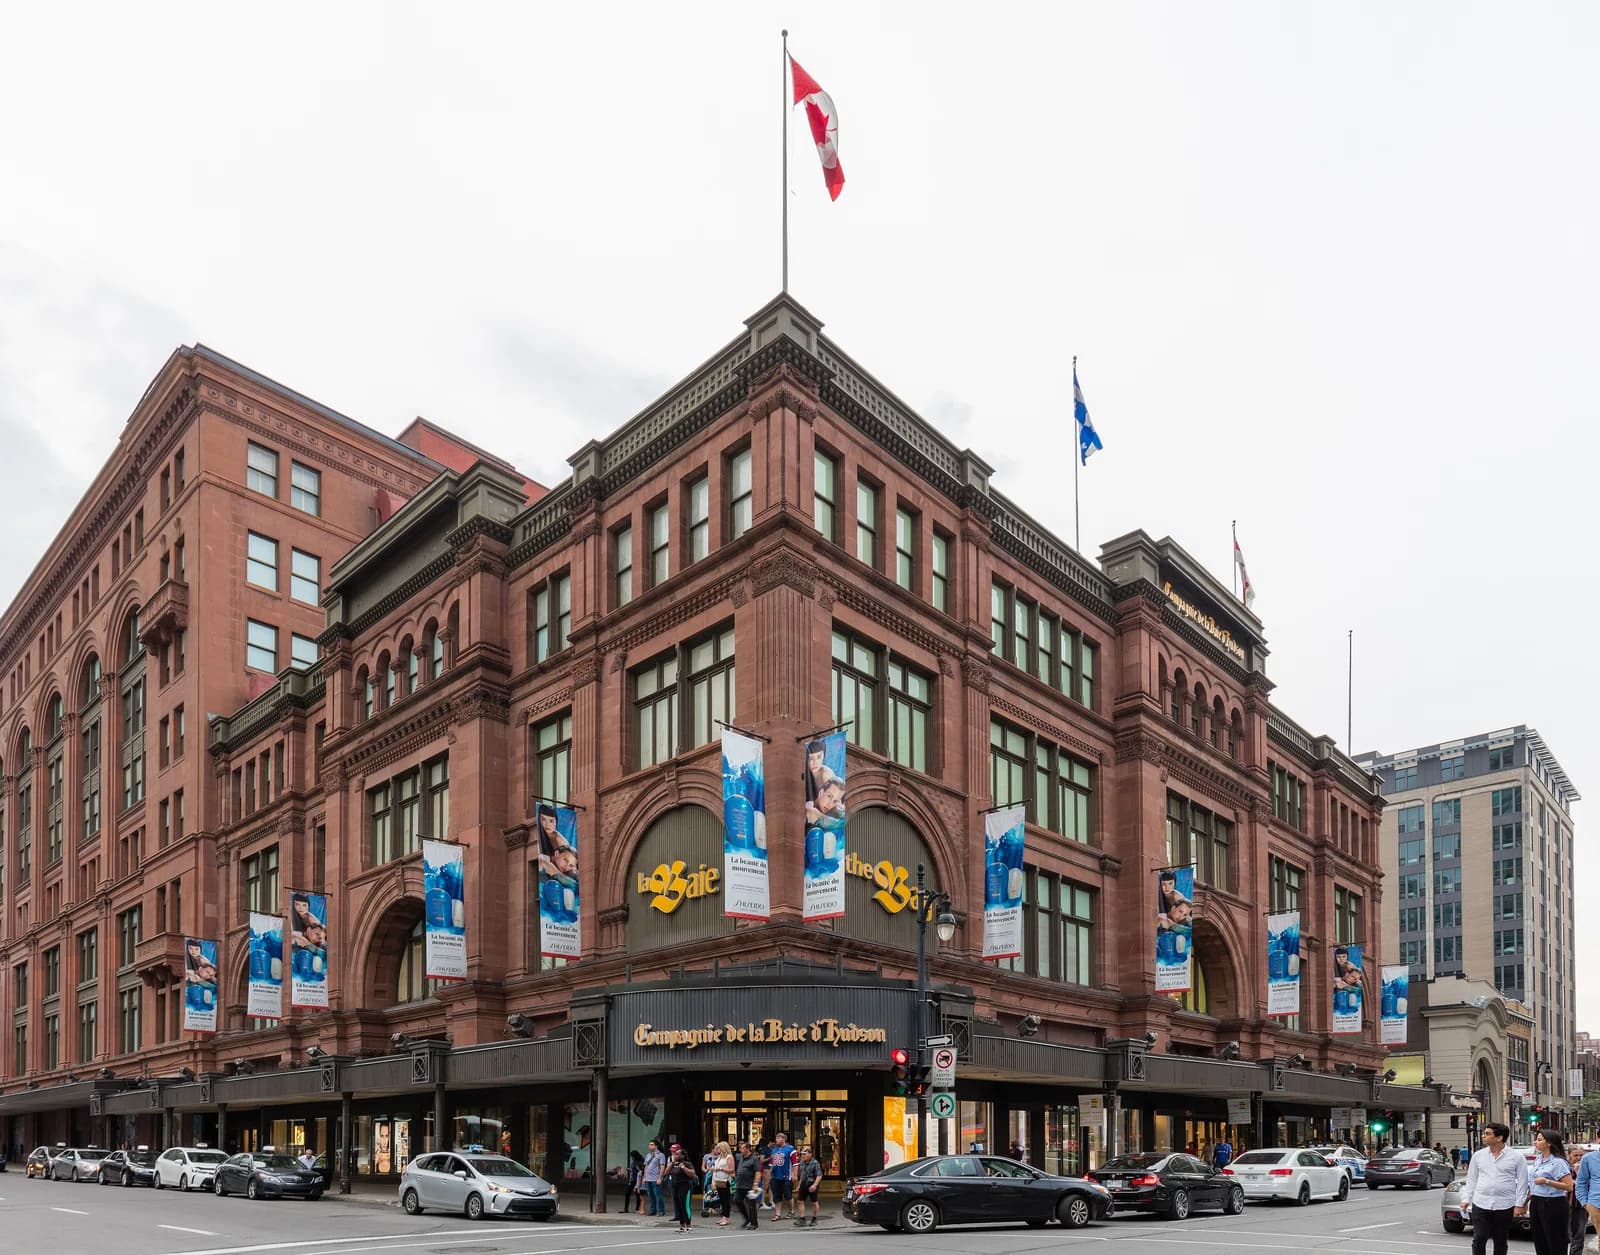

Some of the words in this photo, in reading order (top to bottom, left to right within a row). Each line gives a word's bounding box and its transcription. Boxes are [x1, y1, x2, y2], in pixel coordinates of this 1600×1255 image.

[739, 858, 759, 867] beauté
[845, 852, 873, 880] the
[637, 871, 651, 894] la
[649, 859, 721, 914] Baie
[812, 880, 830, 888] beauté
[735, 900, 765, 909] SHISEIDO
[634, 1023, 723, 1048] Compagnie
[724, 1023, 747, 1042] de
[748, 1022, 764, 1042] la
[763, 1018, 808, 1042] Baie
[809, 1018, 886, 1047] d'Hudson
